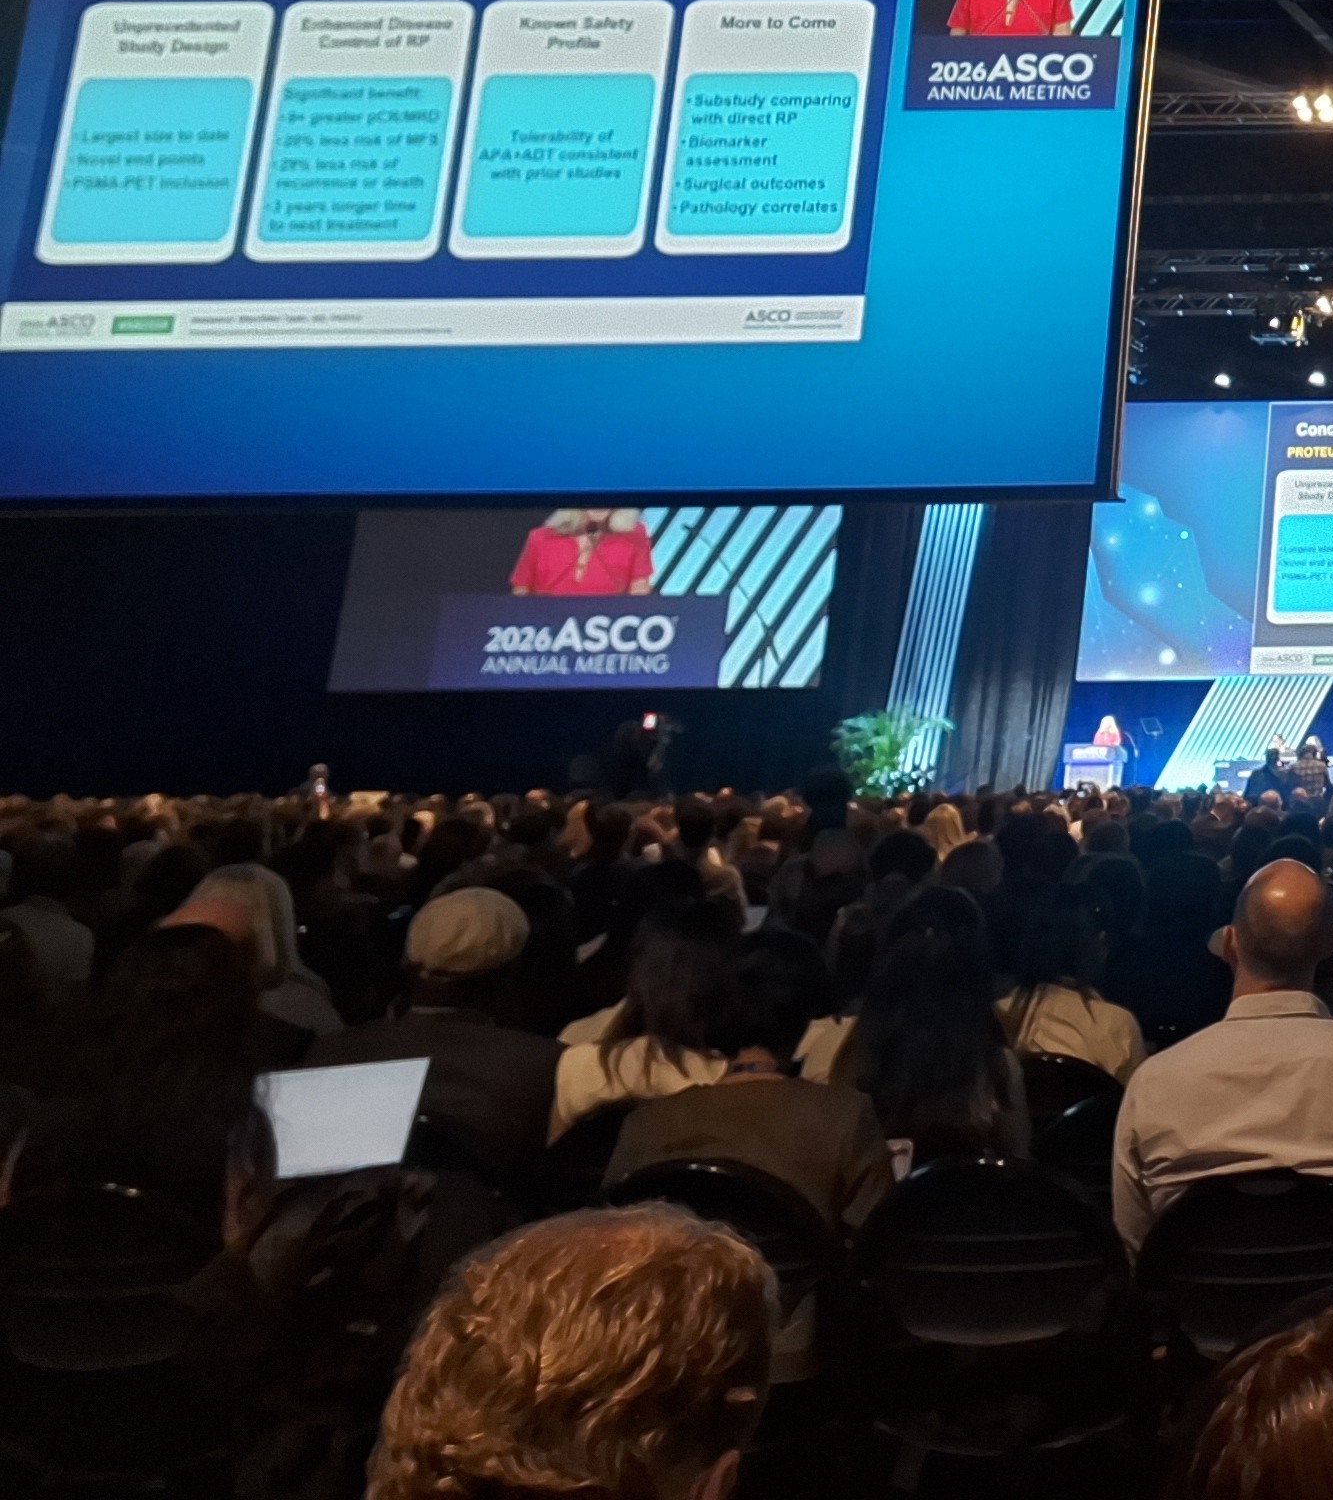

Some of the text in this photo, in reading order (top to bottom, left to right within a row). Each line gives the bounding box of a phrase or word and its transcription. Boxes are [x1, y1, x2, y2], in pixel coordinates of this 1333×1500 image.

[721, 16, 836, 30] More to Come
[927, 84, 1091, 102] ANNUAL MEETING
[694, 93, 851, 109] Substudy comparing
[692, 112, 797, 125] with direct RP
[688, 135, 767, 148] Biomarker
[686, 154, 778, 167] assessment
[684, 177, 825, 192] Surgical outcomes
[680, 201, 837, 215] Pathology correlates
[484, 626, 553, 653] 2026
[481, 653, 669, 676] ANNUAL MEETING
